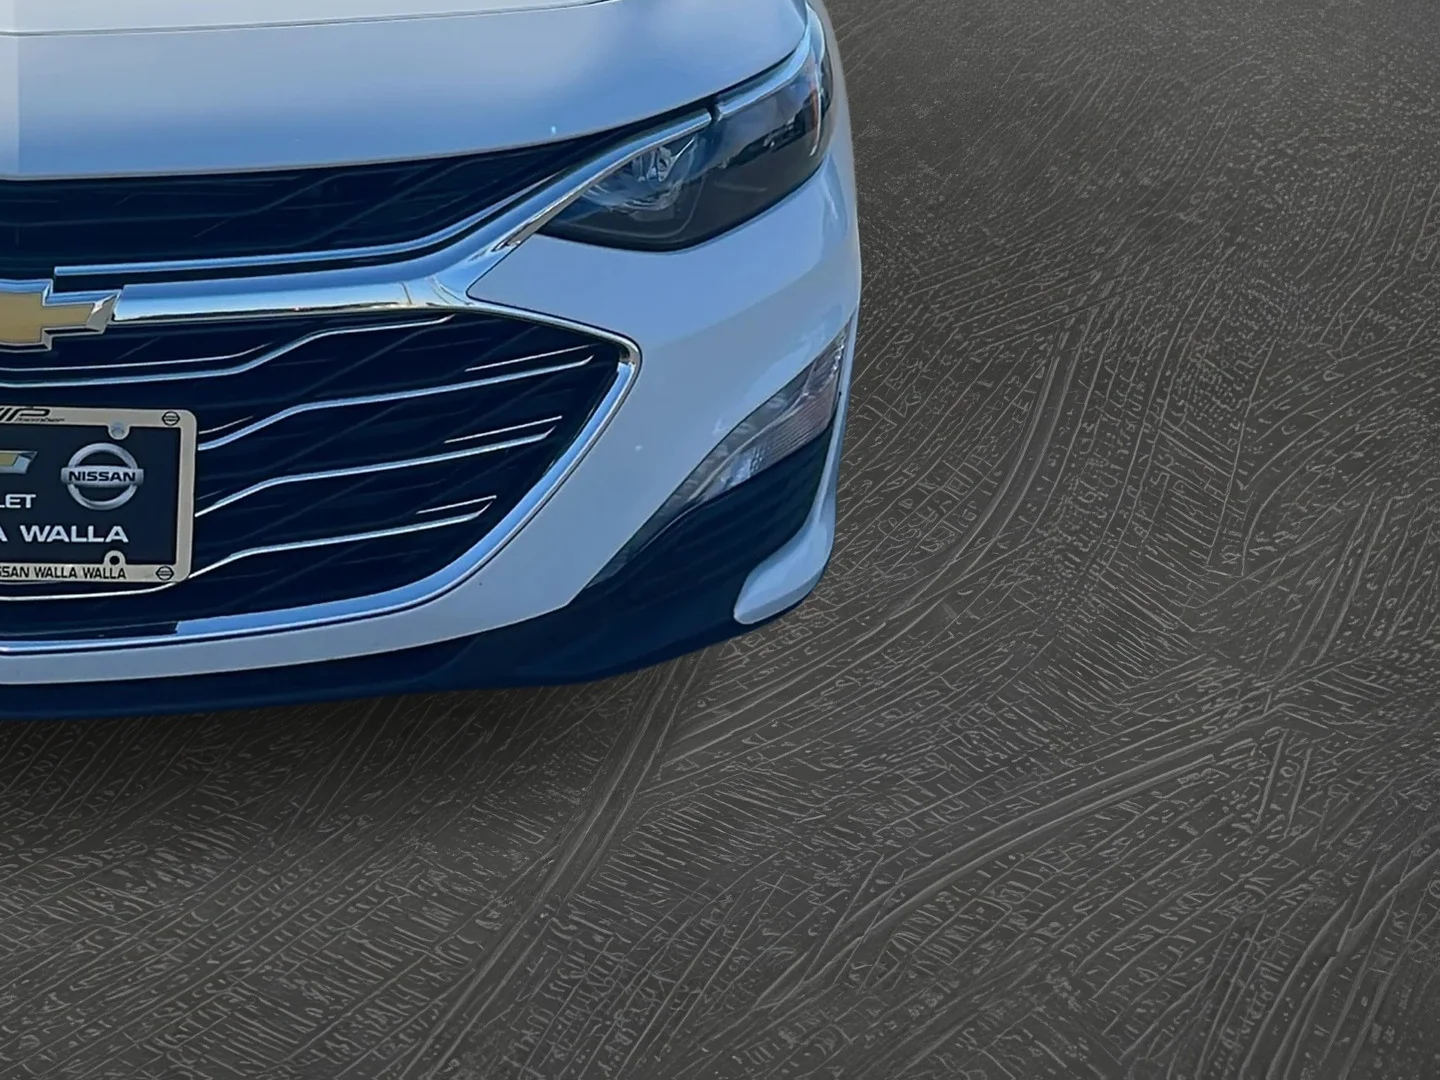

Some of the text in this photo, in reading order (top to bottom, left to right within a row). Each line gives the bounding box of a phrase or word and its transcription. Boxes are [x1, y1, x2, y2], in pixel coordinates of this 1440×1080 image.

[68, 470, 136, 483] NISSAN
[19, 524, 129, 543] WALLA
[34, 566, 78, 579] WALLA
[83, 568, 127, 580] WALLA
